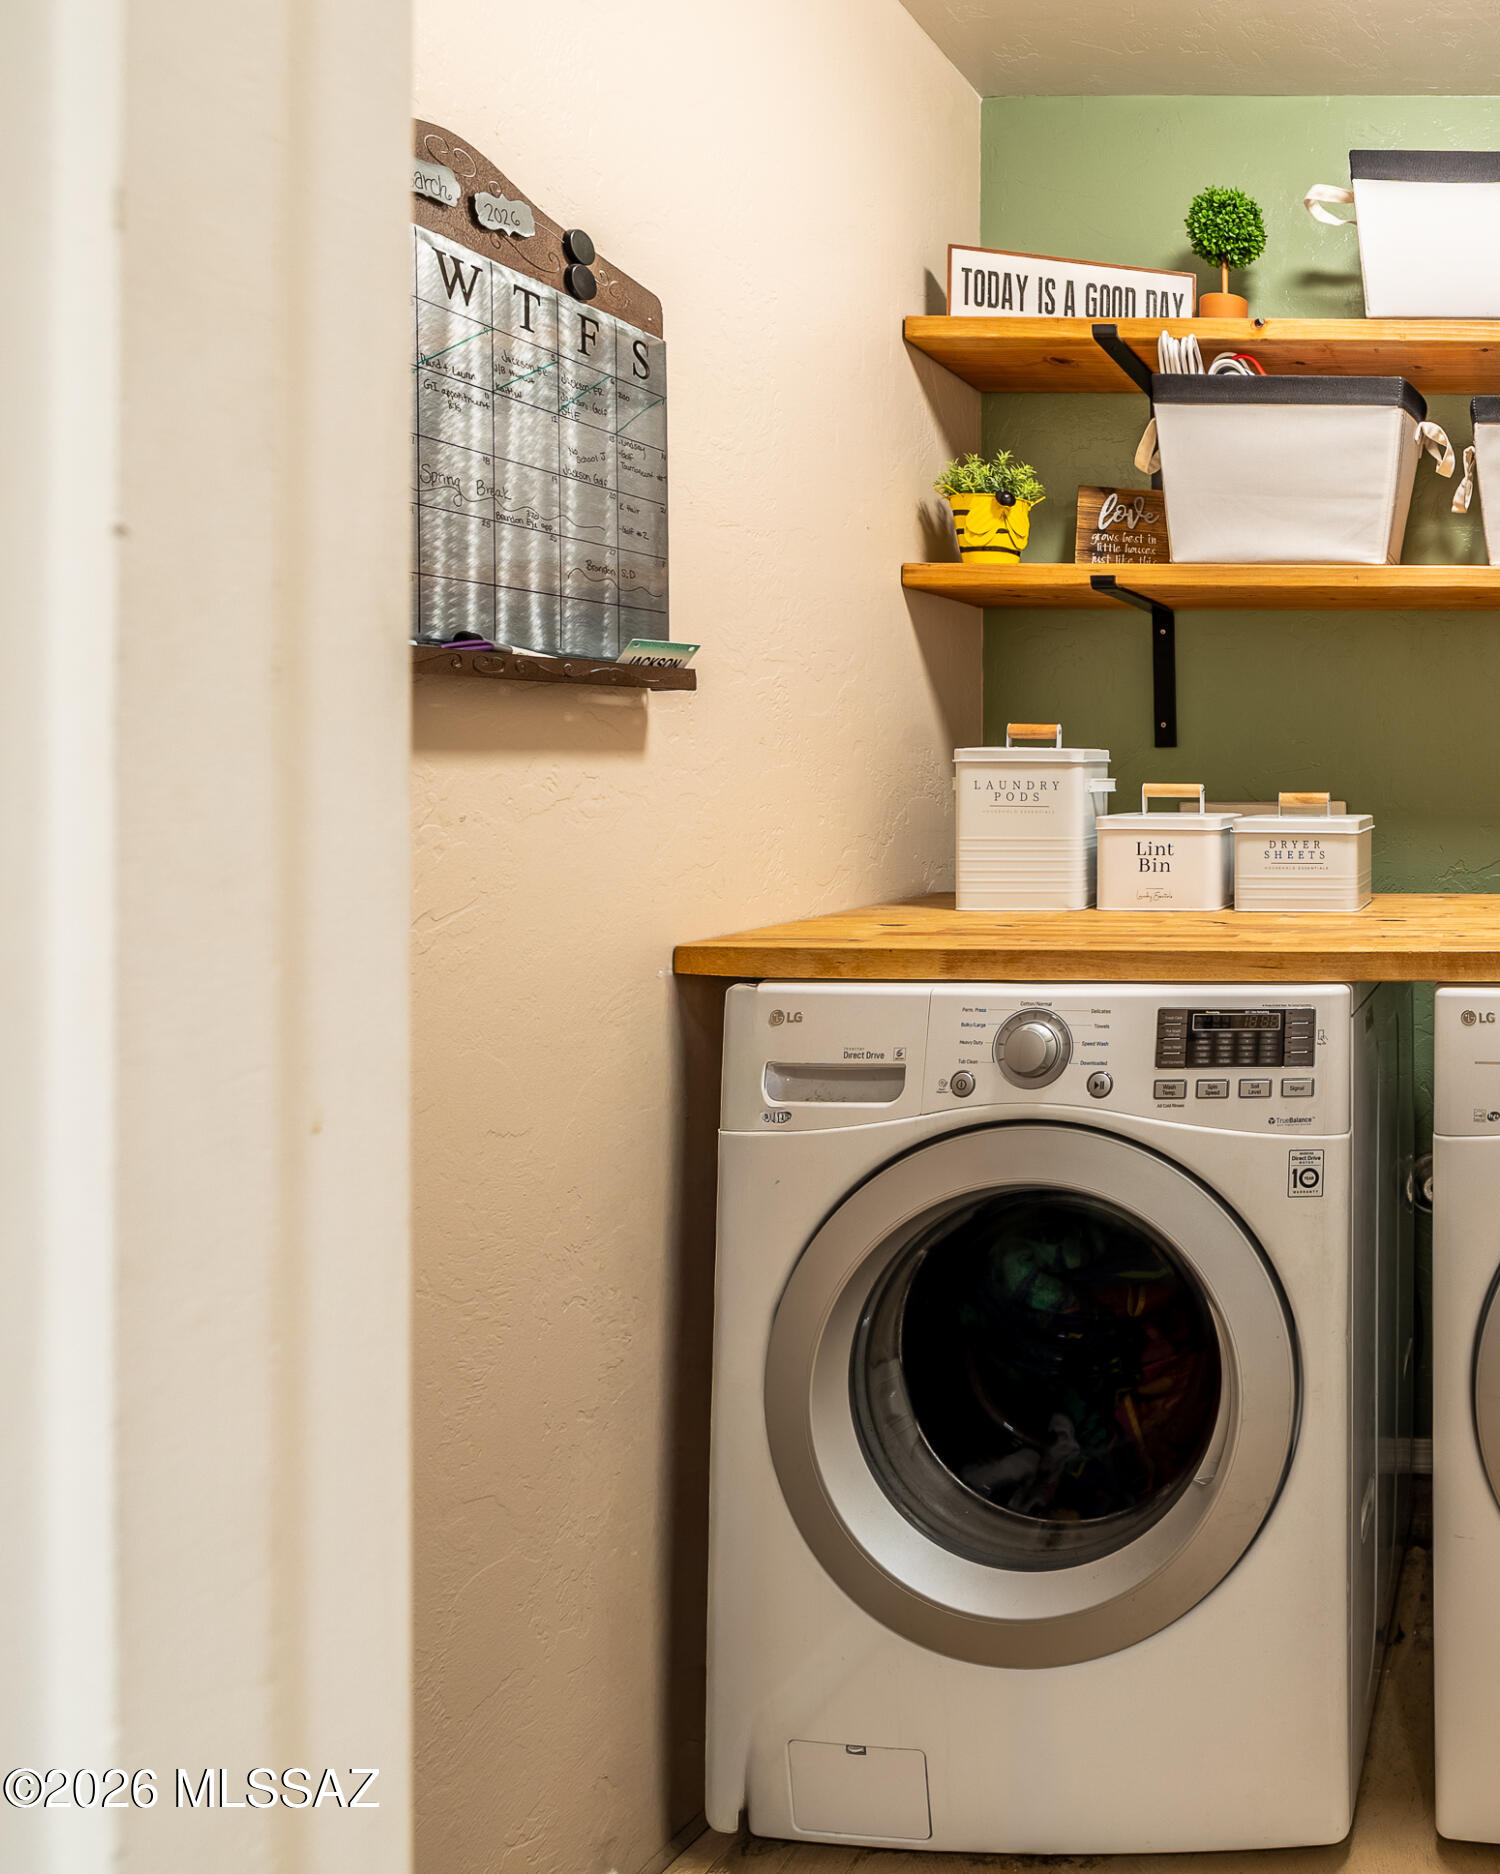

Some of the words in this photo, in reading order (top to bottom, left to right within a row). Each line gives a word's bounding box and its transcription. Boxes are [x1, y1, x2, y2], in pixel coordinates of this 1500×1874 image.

[412, 170, 453, 201] arch
[483, 202, 520, 226] 2026
[961, 267, 1028, 312] TODAY
[1038, 276, 1056, 315] IS
[1064, 280, 1075, 317] A
[1085, 282, 1136, 317] GOOD
[1146, 289, 1184, 317] DAY
[431, 246, 483, 307] W
[513, 284, 541, 333] T
[577, 313, 600, 356] F
[632, 339, 650, 380] S
[420, 463, 463, 507] Spring
[476, 479, 512, 501] Break
[1097, 493, 1160, 530] love
[1090, 532, 1120, 545] grows
[1122, 532, 1144, 544] best
[1147, 534, 1157, 544] in
[1096, 542, 1120, 552] little
[1091, 552, 1111, 564] just
[974, 780, 1060, 790] LAUNDRY
[994, 792, 1040, 801] PODS
[1136, 841, 1174, 856] Lint
[1269, 840, 1321, 849] DRYER
[1264, 850, 1326, 859] SHEETS
[1138, 858, 1171, 872] Bin
[786, 1011, 803, 1023] LG
[1479, 1012, 1496, 1023] LG
[843, 1051, 865, 1059] Direct
[866, 1051, 885, 1059] Drive
[1292, 1168, 1319, 1188] 10
